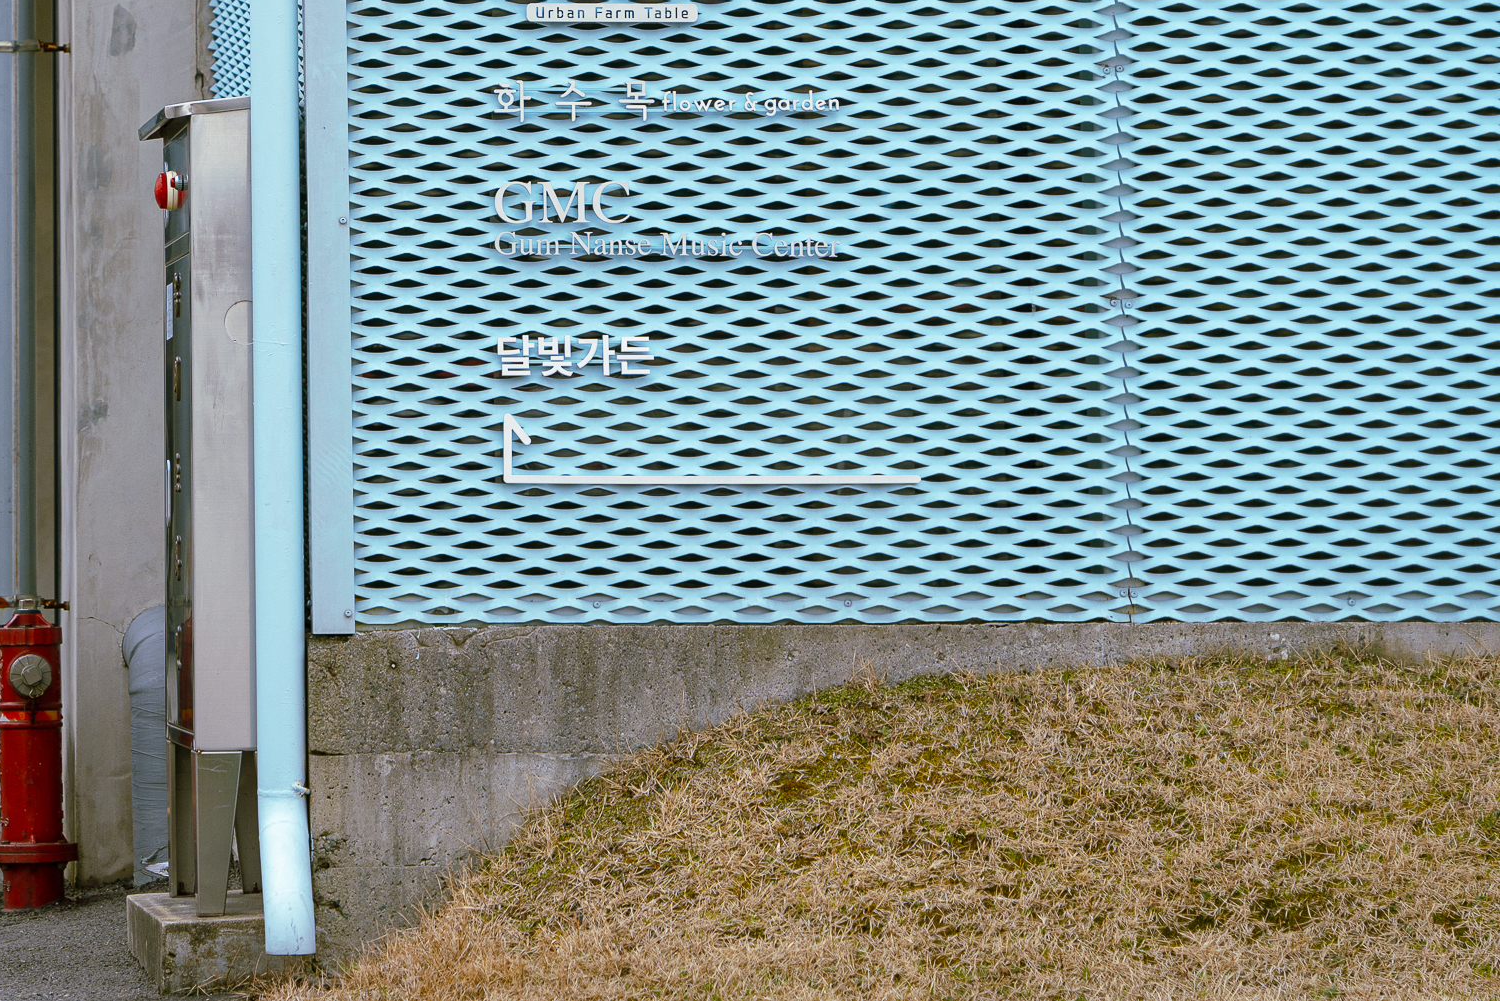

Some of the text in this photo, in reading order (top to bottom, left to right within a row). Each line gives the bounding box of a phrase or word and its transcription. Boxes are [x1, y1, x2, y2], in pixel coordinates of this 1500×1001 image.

[535, 6, 690, 20] Urban Farm Table
[661, 91, 736, 112] flower
[744, 92, 757, 112] &
[764, 90, 840, 116] garden
[494, 181, 631, 224] GMC
[494, 231, 841, 258] Gum Nanse Music Center
[497, 334, 655, 377] 달빛가든
